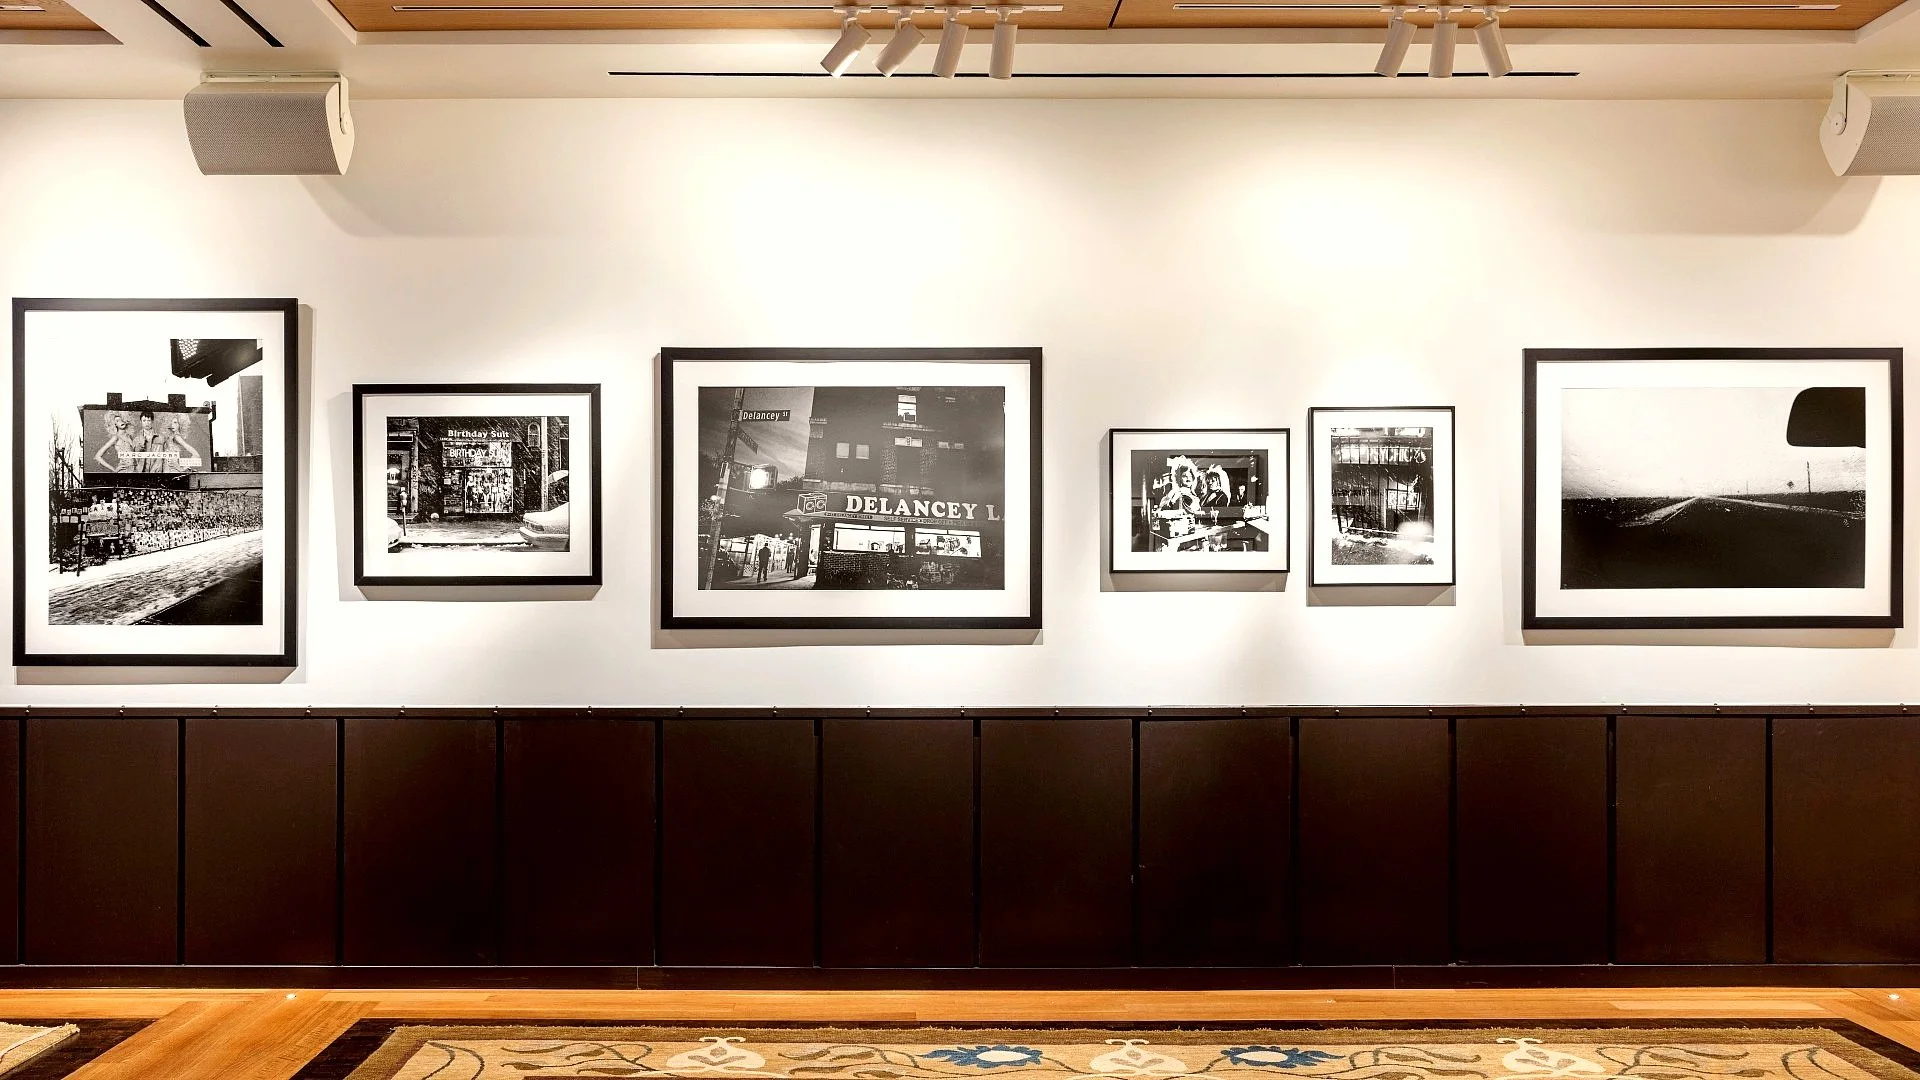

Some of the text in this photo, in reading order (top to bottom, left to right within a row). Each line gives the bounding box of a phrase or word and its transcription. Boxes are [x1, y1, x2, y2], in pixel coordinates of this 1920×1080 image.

[743, 411, 780, 421] Delancey
[448, 430, 510, 438] Birthday Suit
[449, 448, 487, 458] BIRTHDAY
[846, 495, 978, 519] DELANCEY
